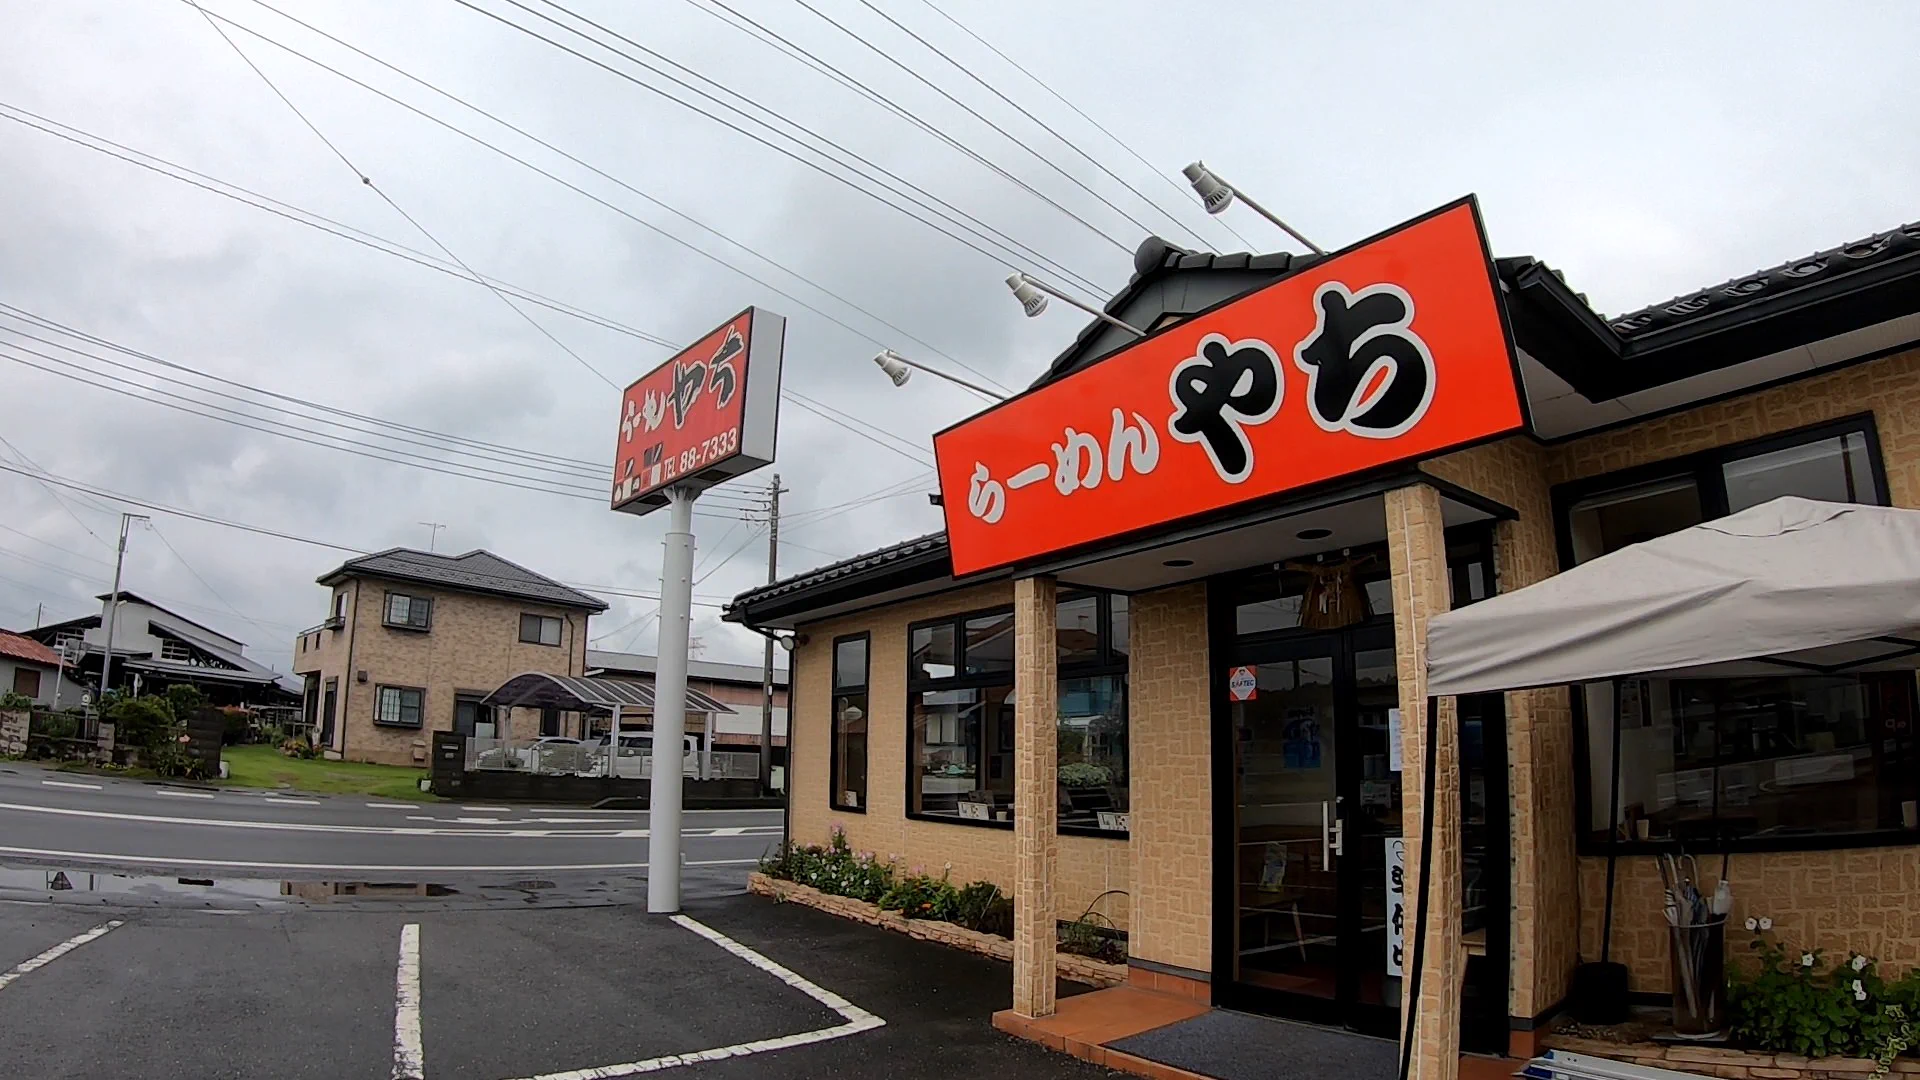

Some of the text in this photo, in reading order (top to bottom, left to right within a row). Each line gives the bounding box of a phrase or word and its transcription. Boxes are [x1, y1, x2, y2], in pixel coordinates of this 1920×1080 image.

[664, 455, 676, 480] TEL
[679, 427, 737, 474] 88-7333
[967, 280, 1436, 525] らーめん やち
